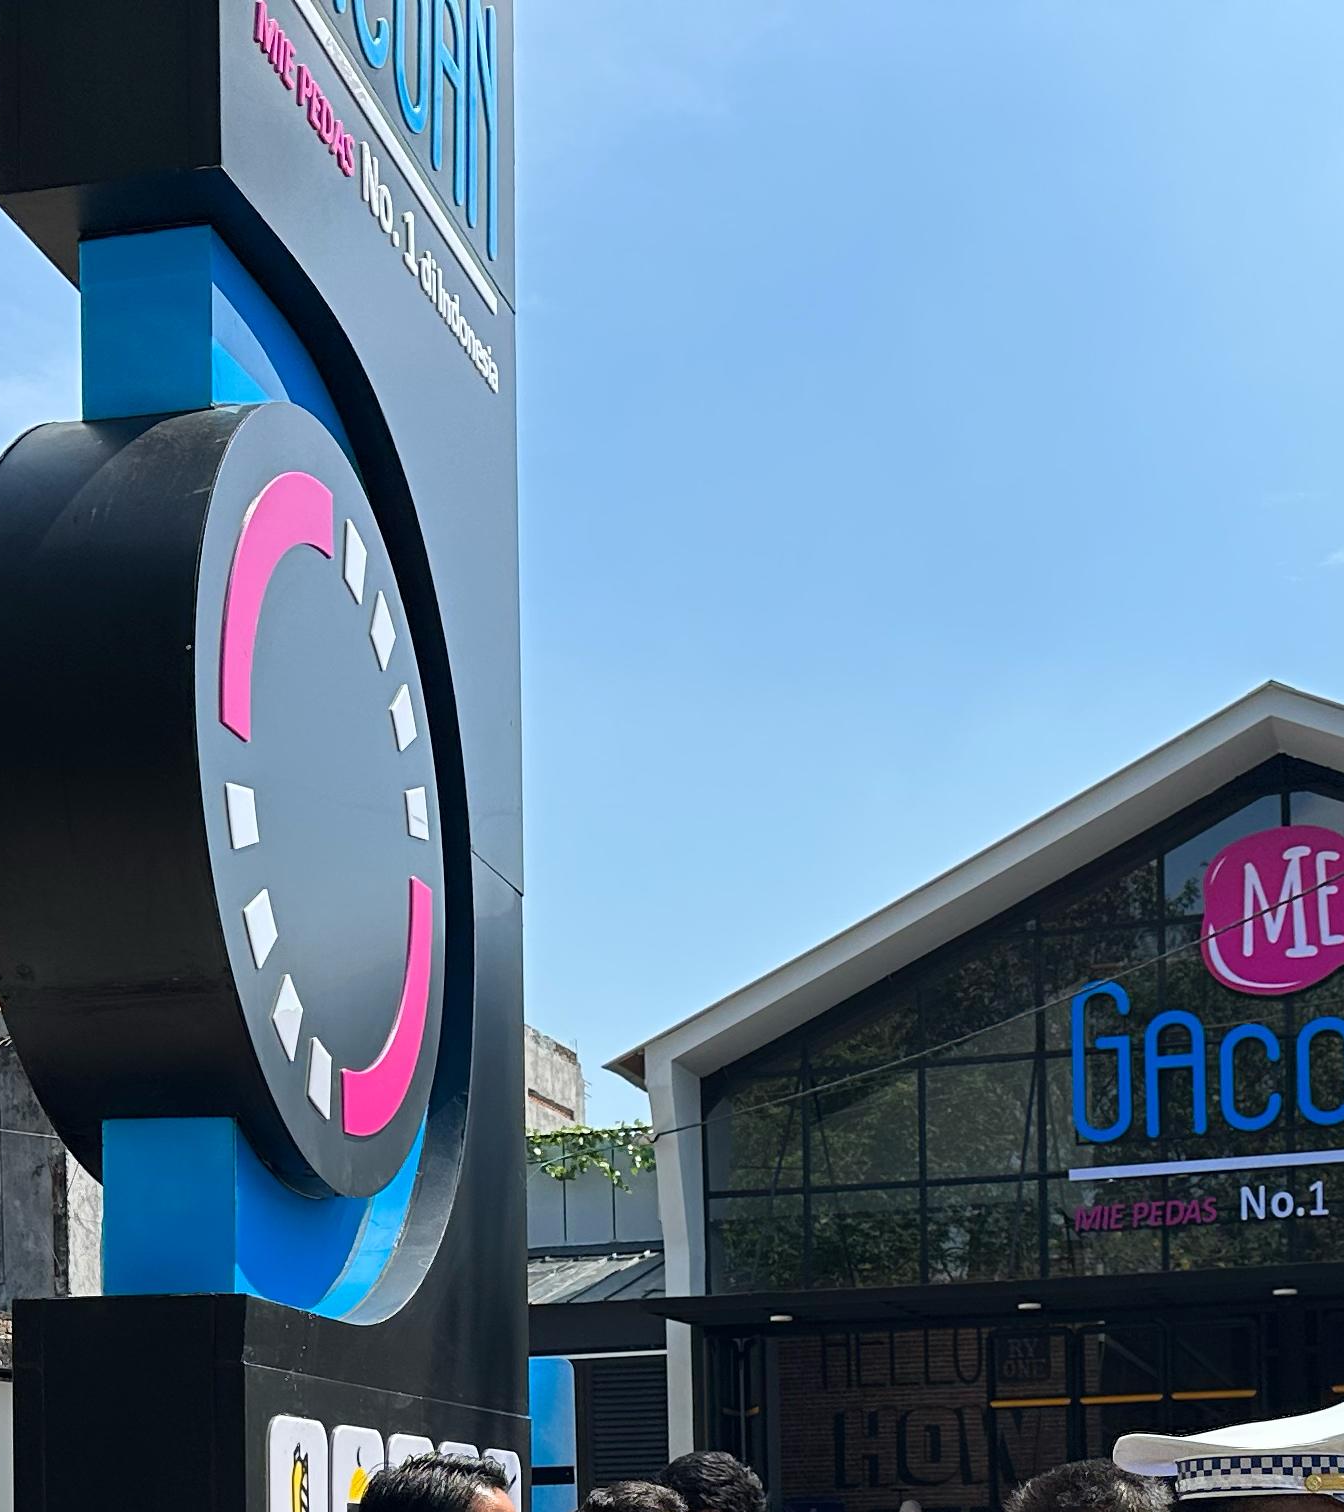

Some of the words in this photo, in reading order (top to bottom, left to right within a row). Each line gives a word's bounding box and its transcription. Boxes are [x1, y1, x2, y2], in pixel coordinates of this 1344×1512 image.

[253, 0, 297, 90] MIE
[296, 63, 355, 177] PEDAS
[419, 250, 437, 304] di
[436, 267, 499, 394] Indonesia
[1075, 1204, 1123, 1233] MIE
[1132, 1197, 1218, 1229] PEDAS
